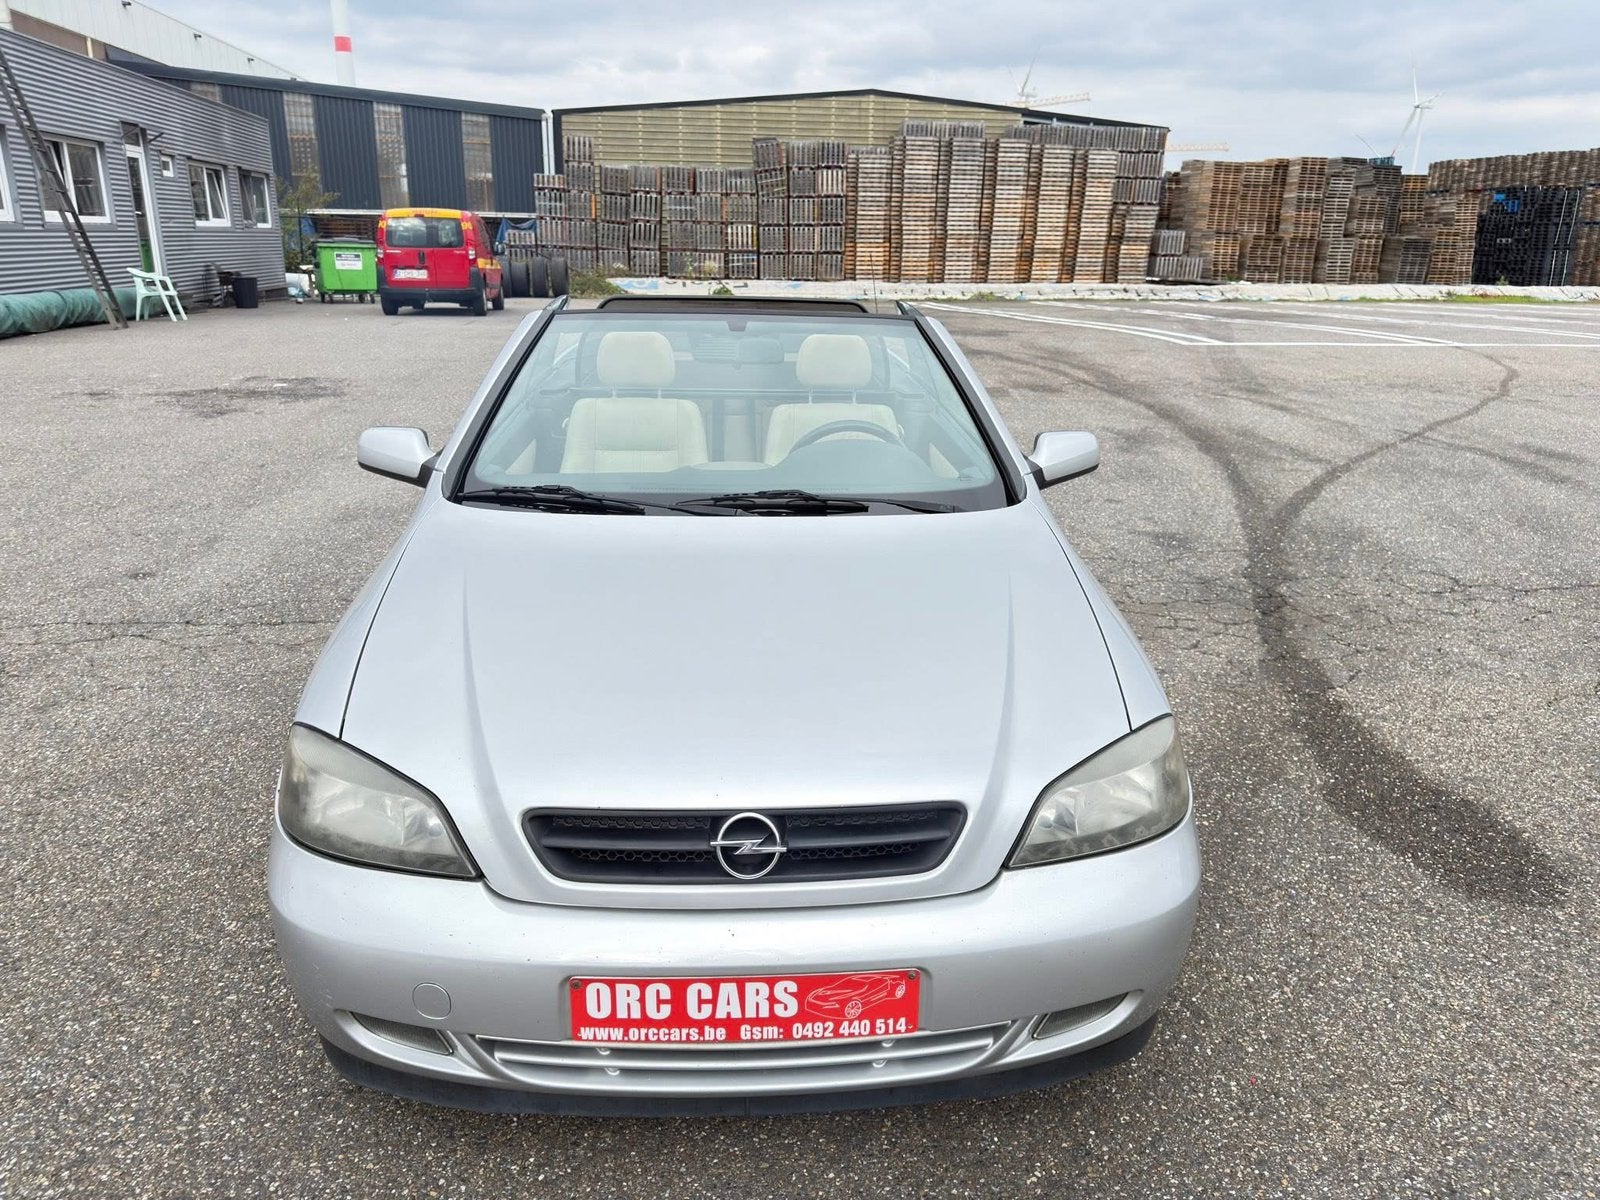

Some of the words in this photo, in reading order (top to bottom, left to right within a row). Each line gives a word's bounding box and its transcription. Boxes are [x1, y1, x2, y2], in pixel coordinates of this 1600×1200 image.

[586, 983, 671, 1020] ORC
[687, 981, 798, 1019] CARS
[580, 1026, 726, 1041] www.orccars.be
[741, 1025, 783, 1040] Gsm:
[793, 1023, 834, 1039] 0492
[839, 1021, 870, 1036] 440
[876, 1018, 906, 1034] 514
